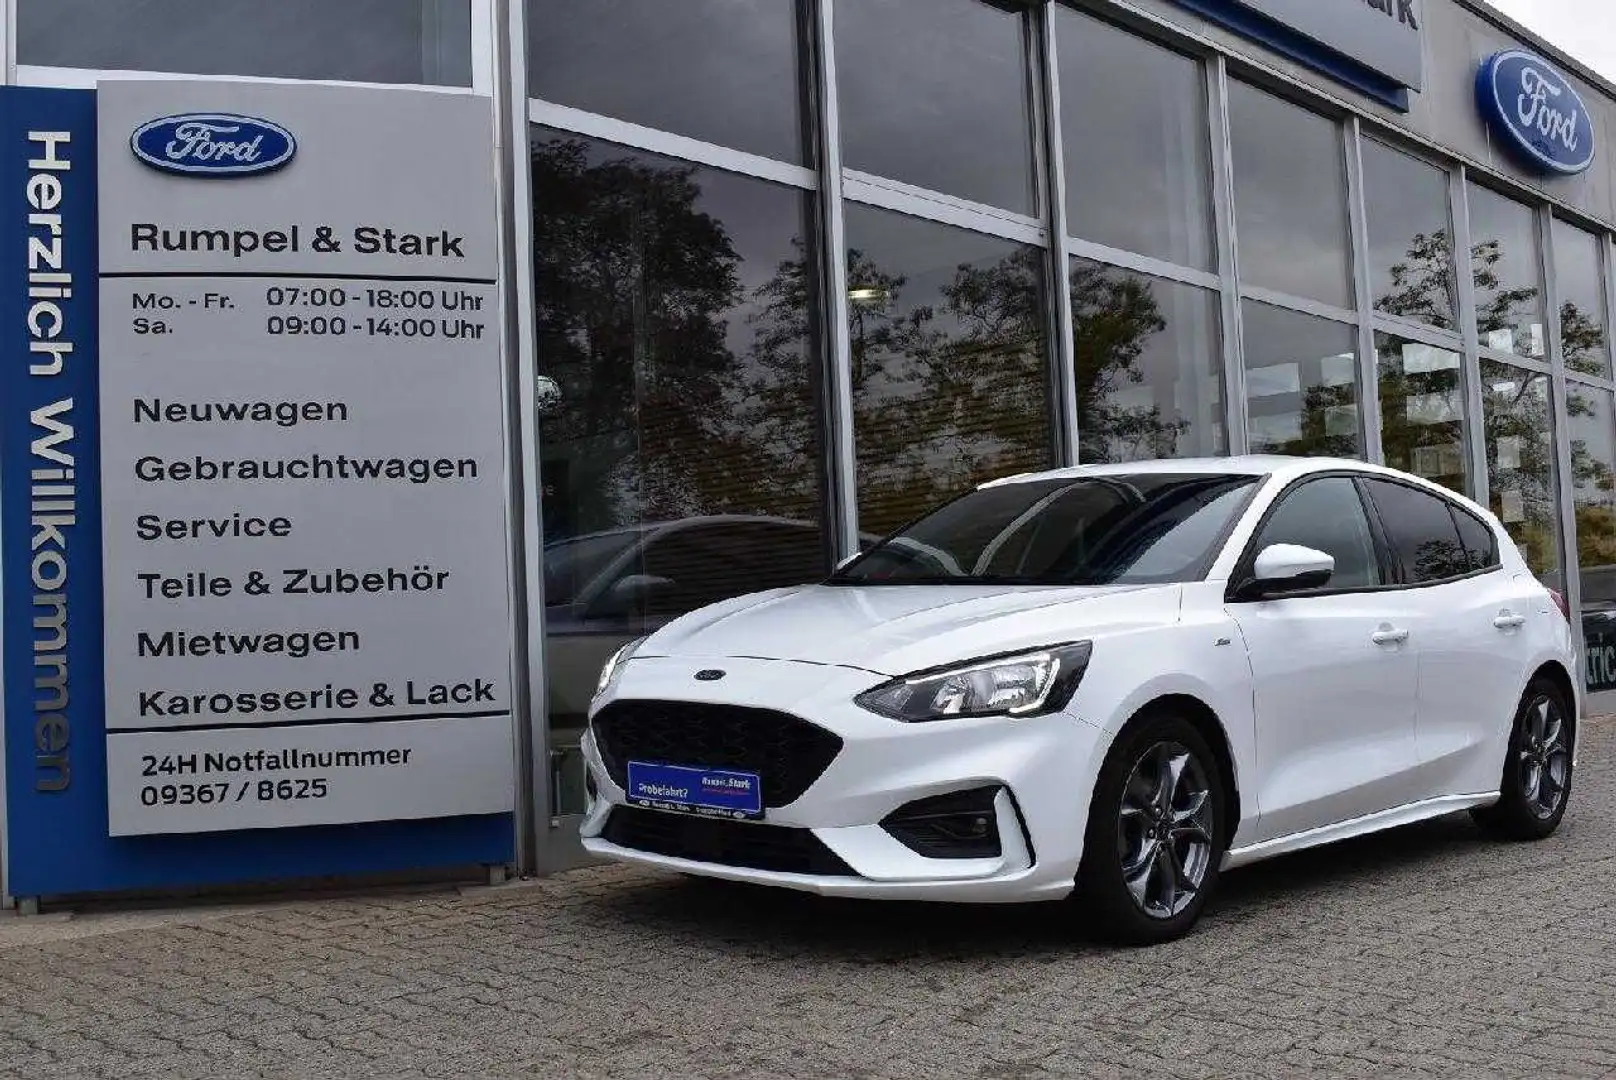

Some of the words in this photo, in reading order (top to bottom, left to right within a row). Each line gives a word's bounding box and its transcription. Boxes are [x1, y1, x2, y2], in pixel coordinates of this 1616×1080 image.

[1517, 66, 1577, 152] Ford
[165, 122, 264, 162] Ford
[26, 131, 74, 375] Herzlich
[131, 223, 299, 258] Rumpel
[311, 226, 342, 253] &
[353, 227, 466, 260] Stark
[132, 292, 182, 309] Mo.
[204, 292, 235, 309] Fr.
[266, 286, 347, 307] 07:00
[365, 289, 435, 309] 18:00
[440, 290, 484, 311] Uhr
[131, 317, 173, 335] Sa.
[267, 315, 347, 336] 09:00
[366, 317, 436, 338] 14:00
[440, 319, 485, 340] Uhr
[133, 398, 348, 427] Neuwagen
[134, 453, 478, 484] Gebrauchtwagen
[136, 512, 293, 541] Service
[30, 397, 76, 792] Willkommen
[137, 571, 233, 599] Teile
[243, 570, 272, 596] &
[282, 564, 450, 595] Zubehör
[137, 628, 360, 659] Mietwagen
[139, 683, 359, 717] Karosserie
[368, 682, 396, 707] &
[406, 678, 497, 706] Lack
[141, 753, 198, 777] 24H
[204, 747, 412, 773] Notfallnummer
[140, 782, 230, 807] 09367
[234, 779, 253, 802] /
[257, 777, 328, 801] 8625
